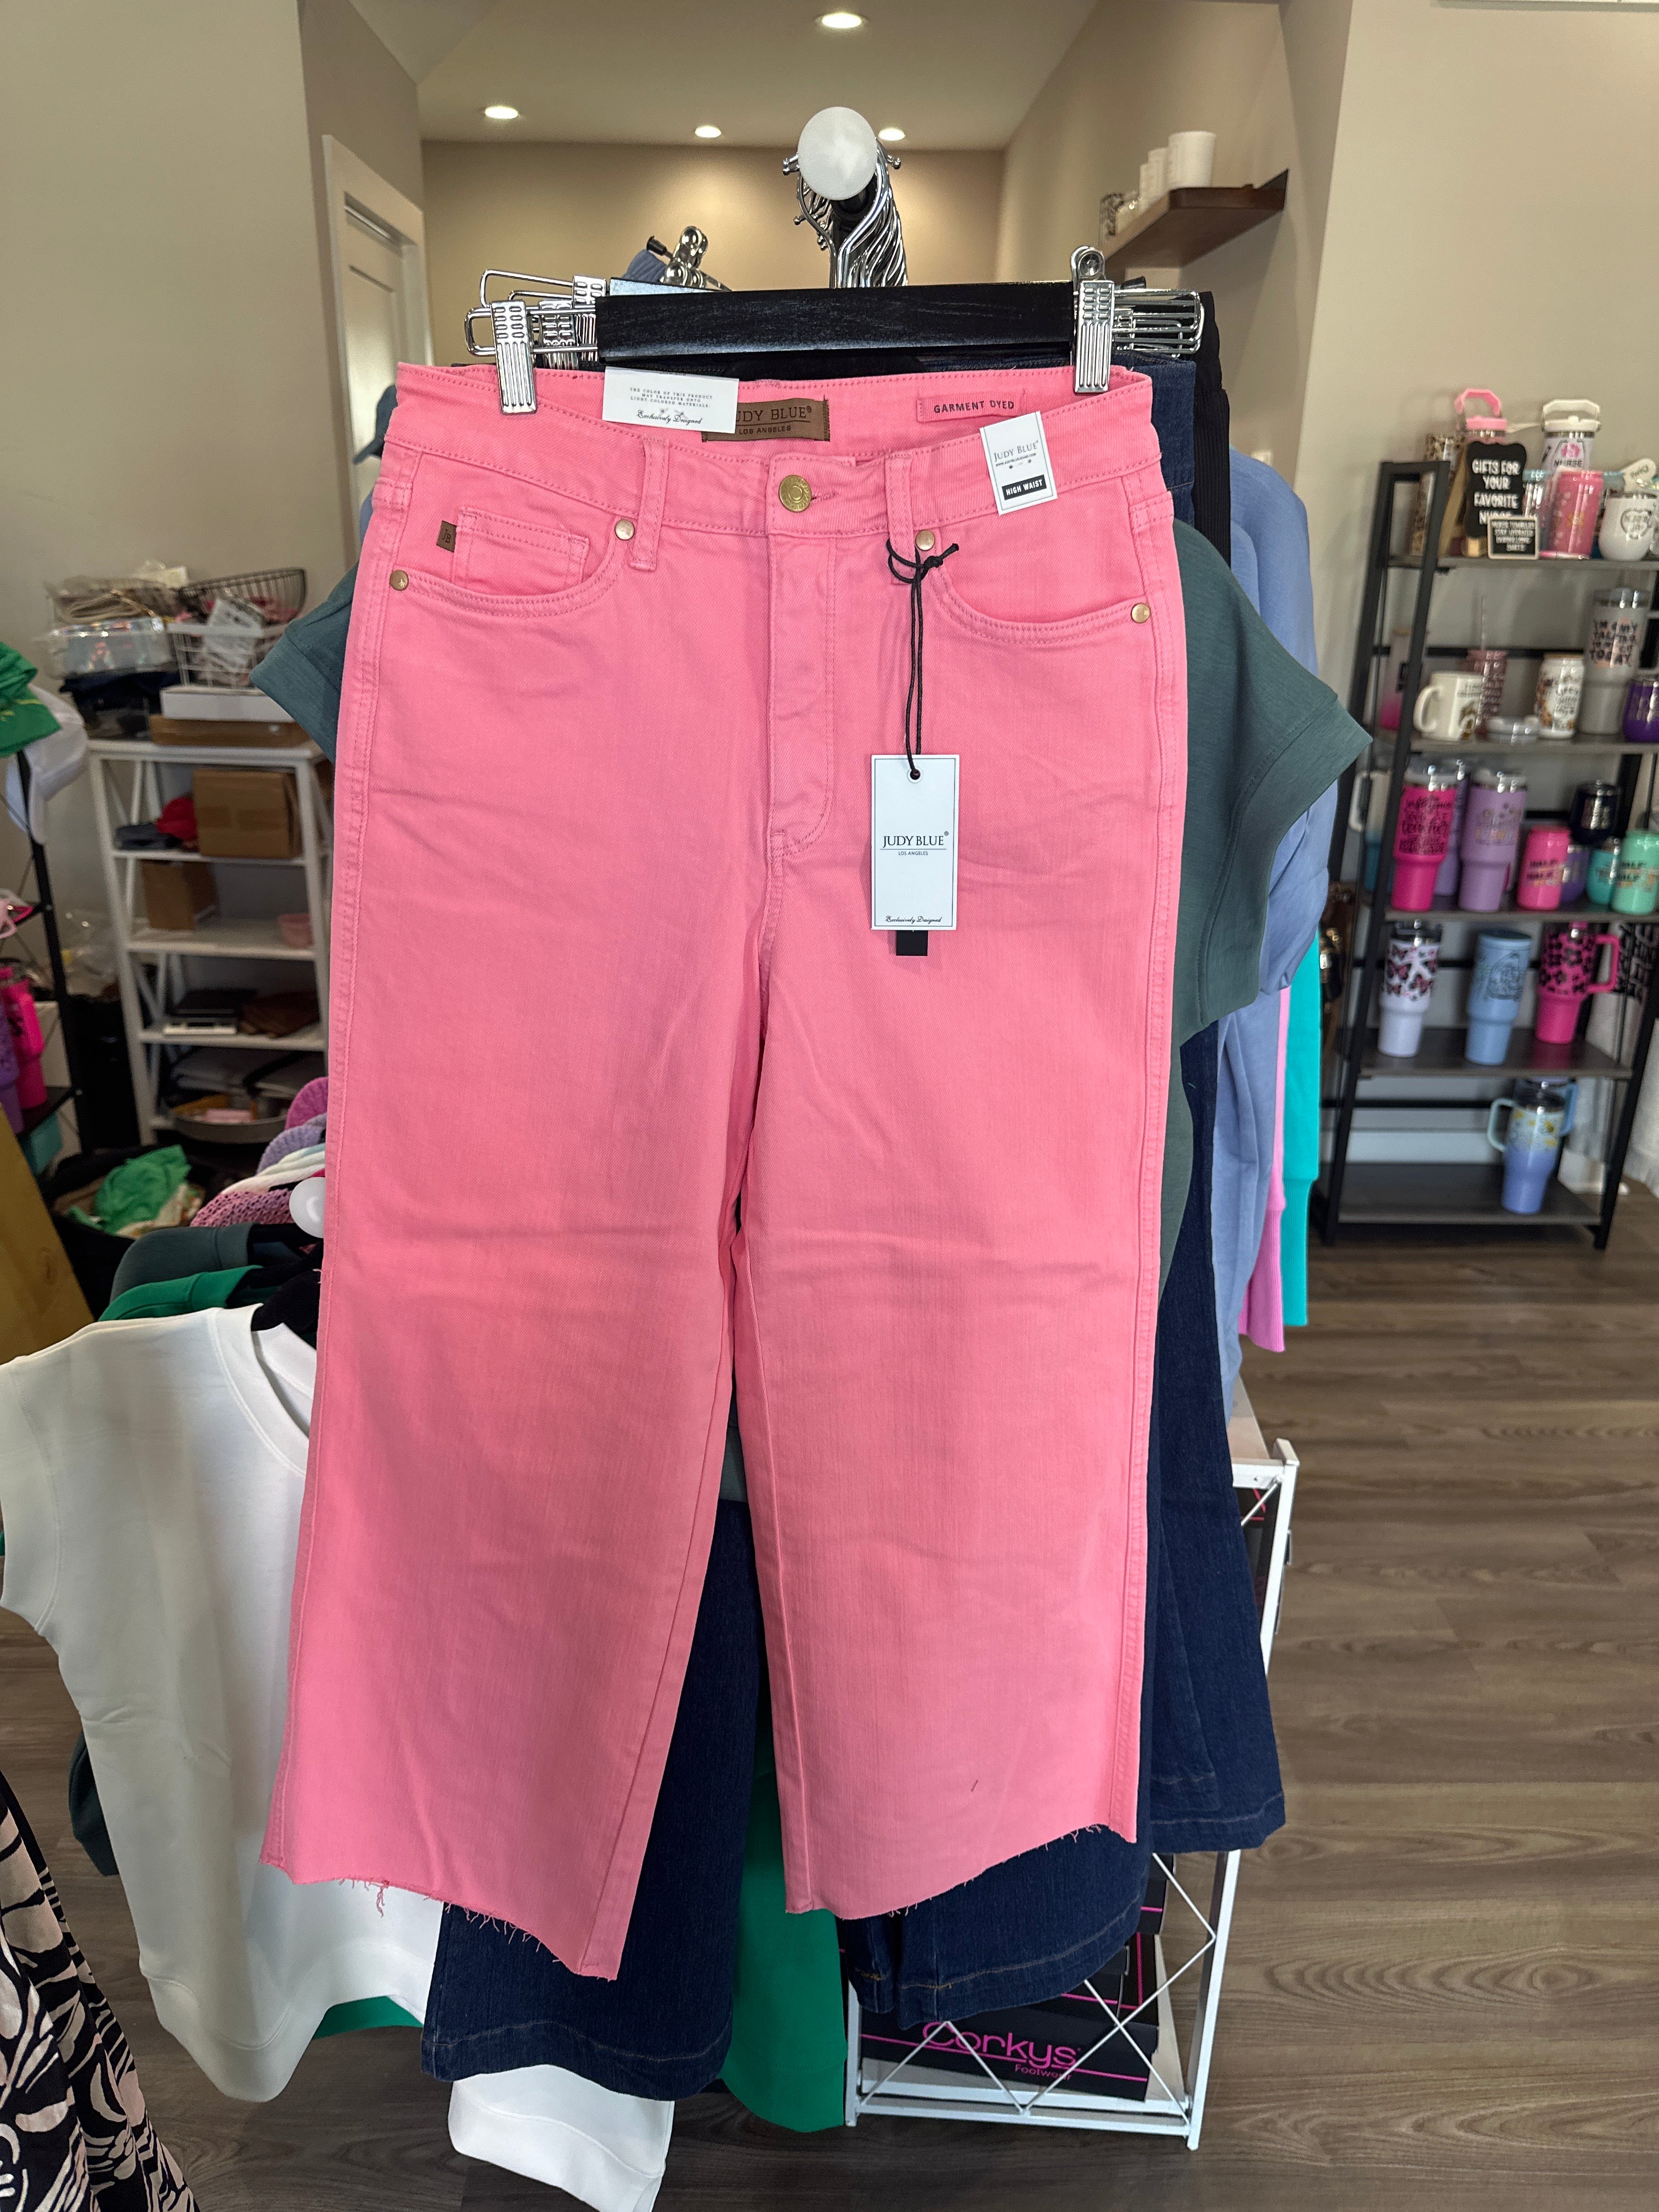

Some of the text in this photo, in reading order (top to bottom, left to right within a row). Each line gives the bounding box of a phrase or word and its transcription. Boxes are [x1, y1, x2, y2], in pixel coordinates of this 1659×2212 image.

[934, 400, 1014, 413] GARMENT DYED
[636, 410, 703, 426] Exclusively Designed
[736, 410, 764, 422] UDY
[757, 425, 791, 434] ANGELES
[994, 448, 1014, 462] JUDY
[1472, 459, 1521, 476] GIFTS FOR
[1006, 479, 1042, 496] HIGH WAIST
[1482, 475, 1511, 490] YOUR
[1474, 492, 1519, 509] FAVORITE
[883, 836, 914, 848] JUDY
[916, 916, 943, 924] Designed
[922, 2021, 1076, 2069] Corkys
